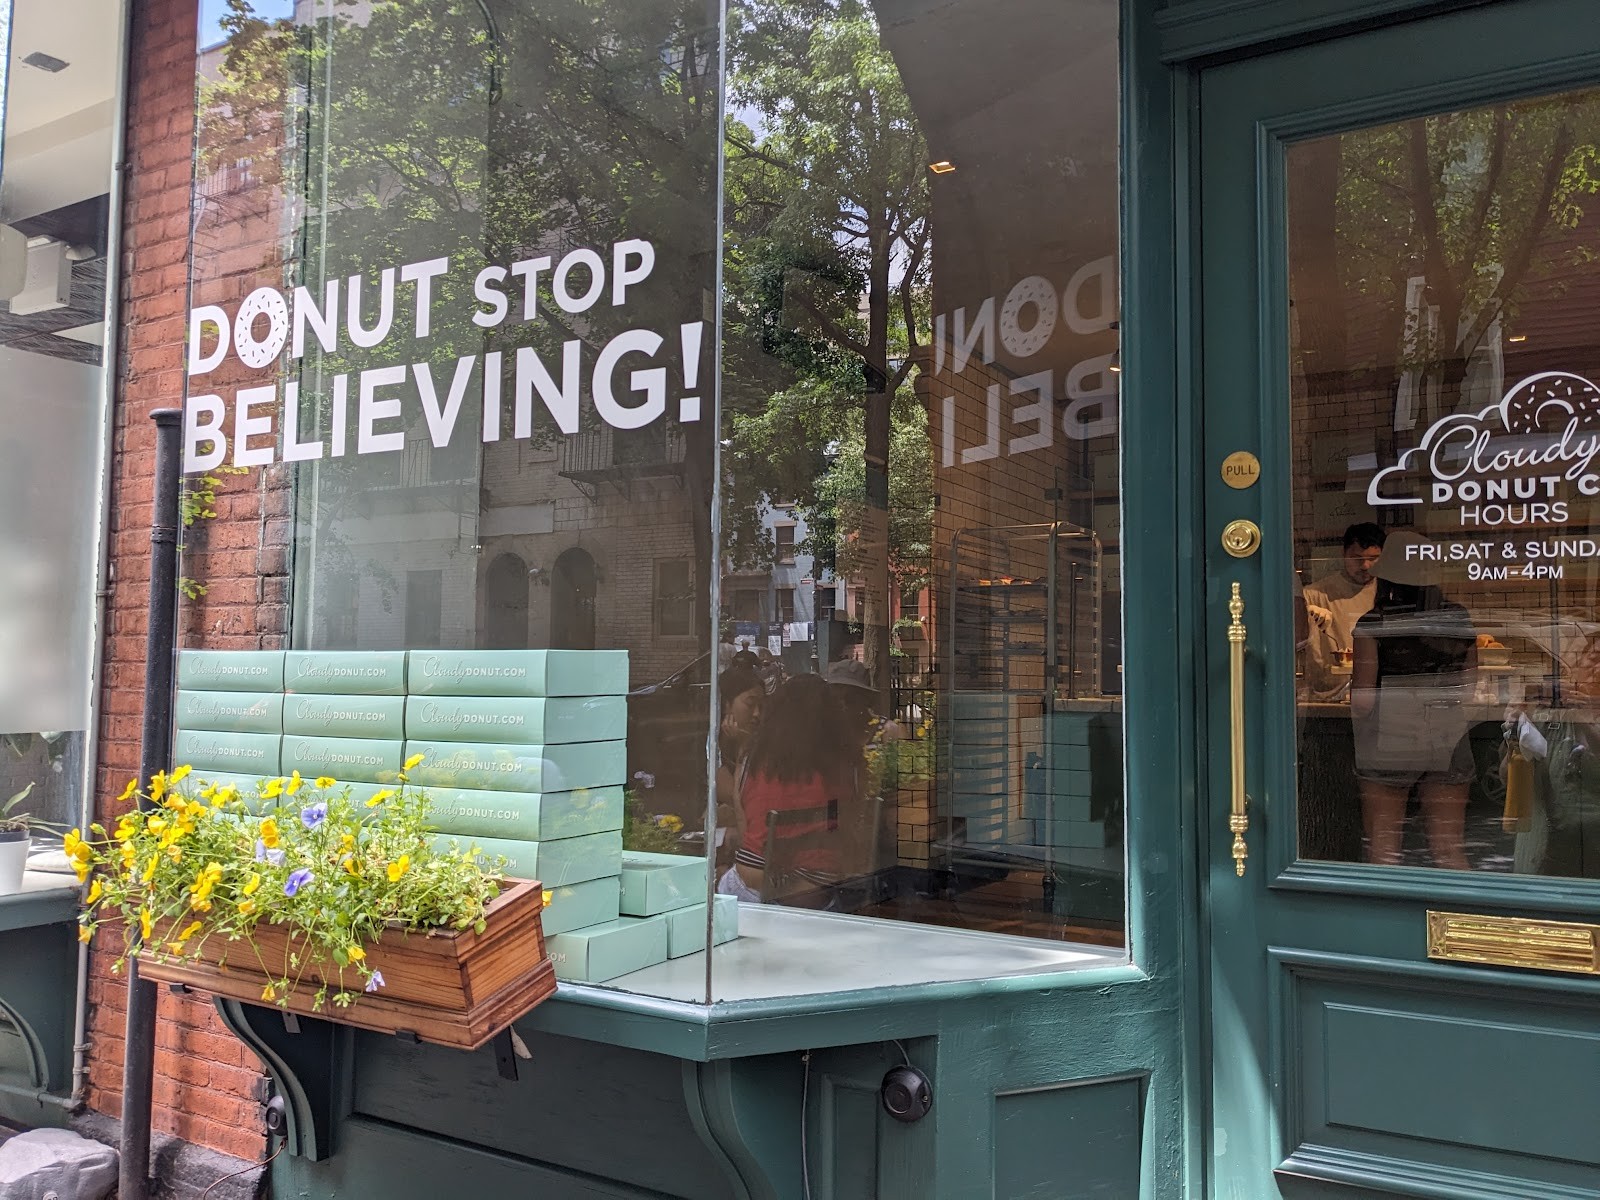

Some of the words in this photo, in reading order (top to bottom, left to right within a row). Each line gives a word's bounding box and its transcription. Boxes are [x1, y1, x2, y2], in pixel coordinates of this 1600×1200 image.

[188, 257, 448, 376] DONUT
[471, 238, 655, 329] STOP
[184, 321, 703, 474] BELIEVING!
[1430, 416, 1600, 481] Cloudy
[1226, 465, 1256, 476] PULL
[1432, 476, 1561, 503] DONUT
[1460, 501, 1569, 526] HOURS
[1501, 542, 1518, 559] &
